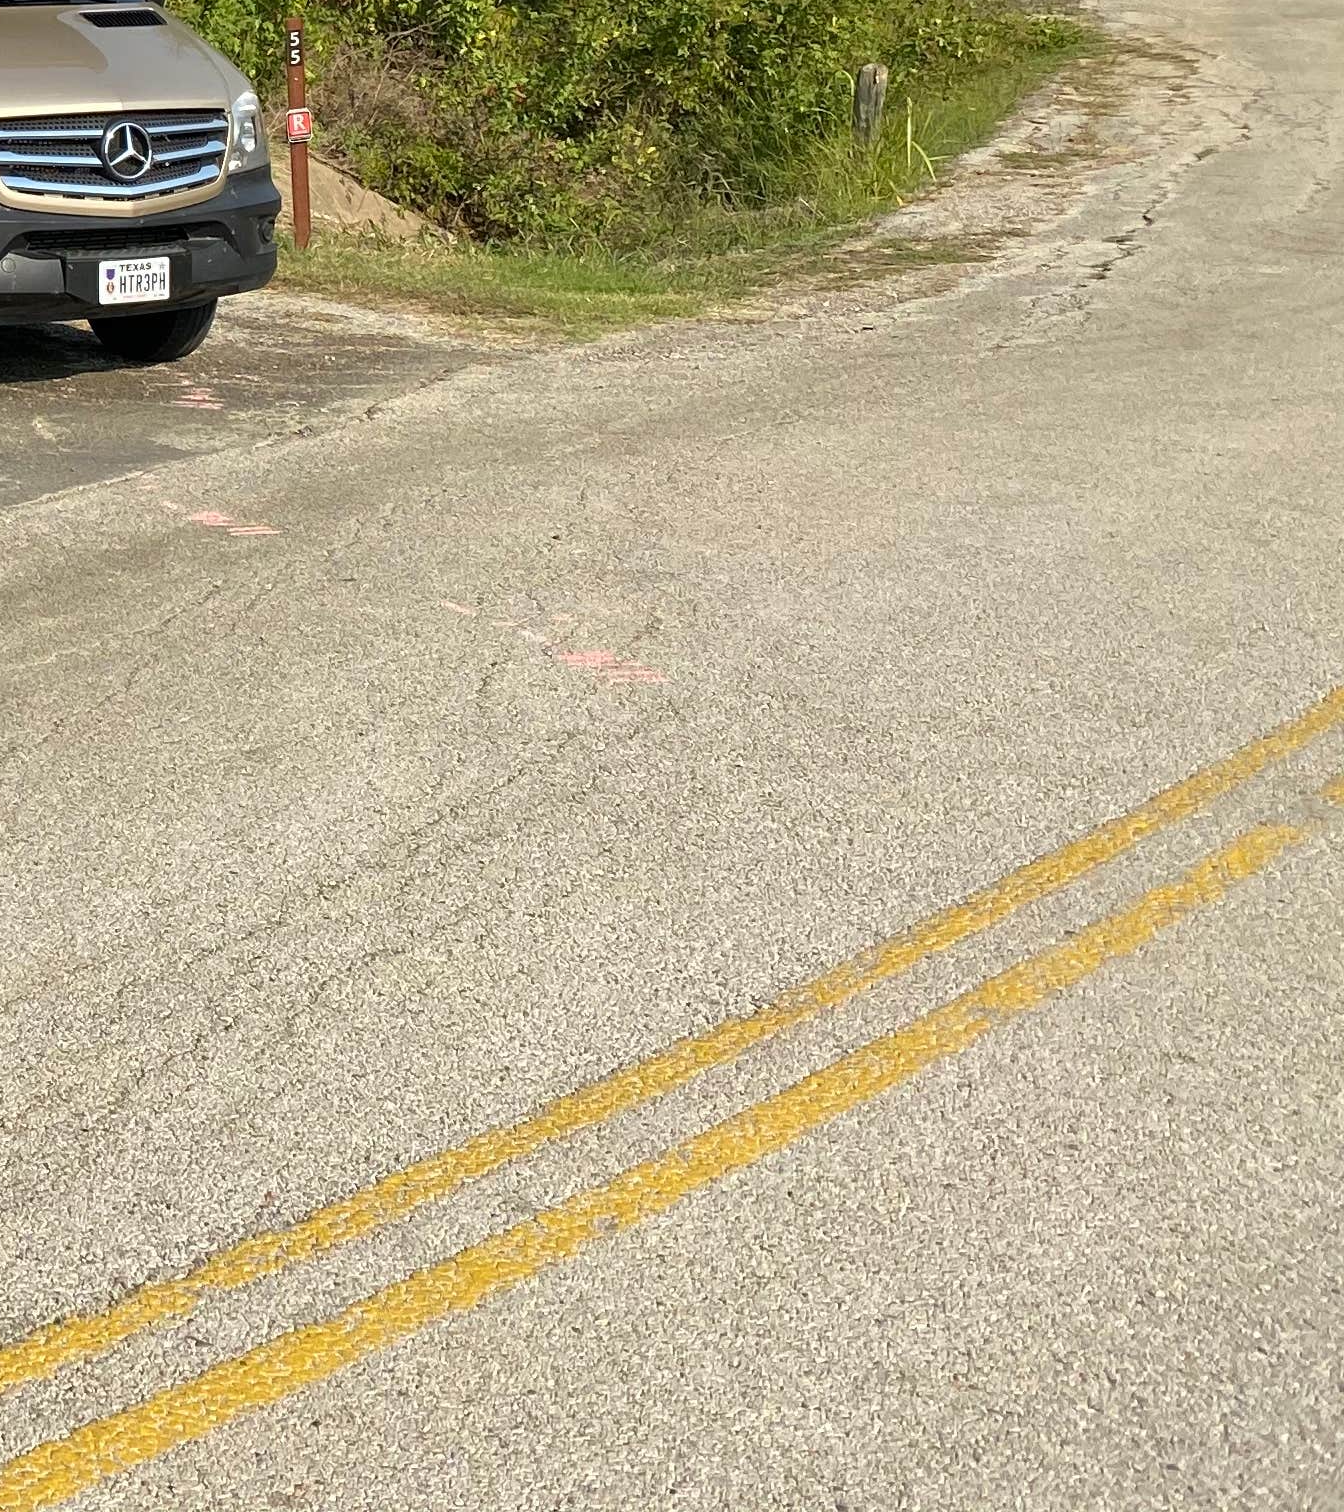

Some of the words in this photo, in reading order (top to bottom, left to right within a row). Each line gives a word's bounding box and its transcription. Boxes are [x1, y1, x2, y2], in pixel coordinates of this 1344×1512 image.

[293, 113, 306, 131] R
[119, 262, 152, 272] TEXAS
[119, 272, 166, 294] HTR3PH
